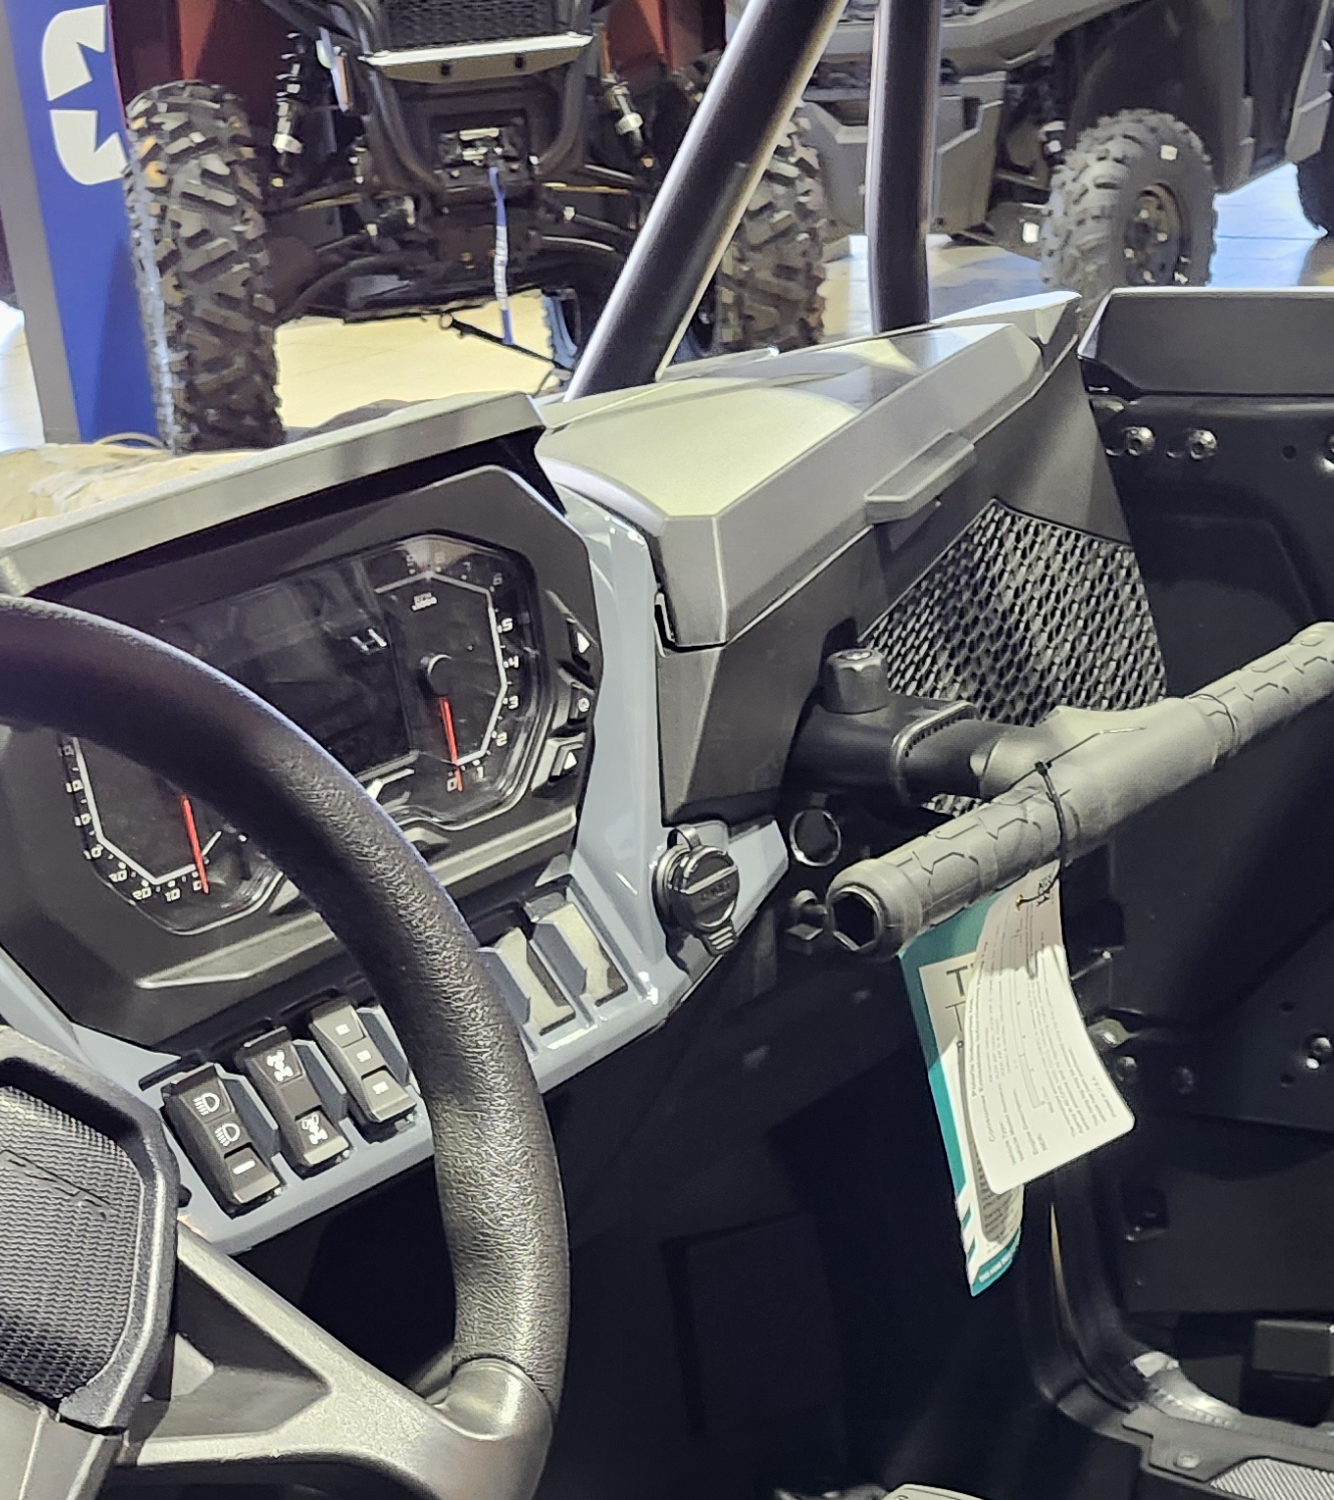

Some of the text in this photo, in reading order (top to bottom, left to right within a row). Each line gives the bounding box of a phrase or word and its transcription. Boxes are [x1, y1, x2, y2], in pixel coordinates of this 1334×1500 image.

[501, 617, 514, 632] 5
[508, 655, 520, 668] 4
[508, 695, 519, 710] 3
[496, 731, 508, 747] 2
[165, 888, 182, 902] 10
